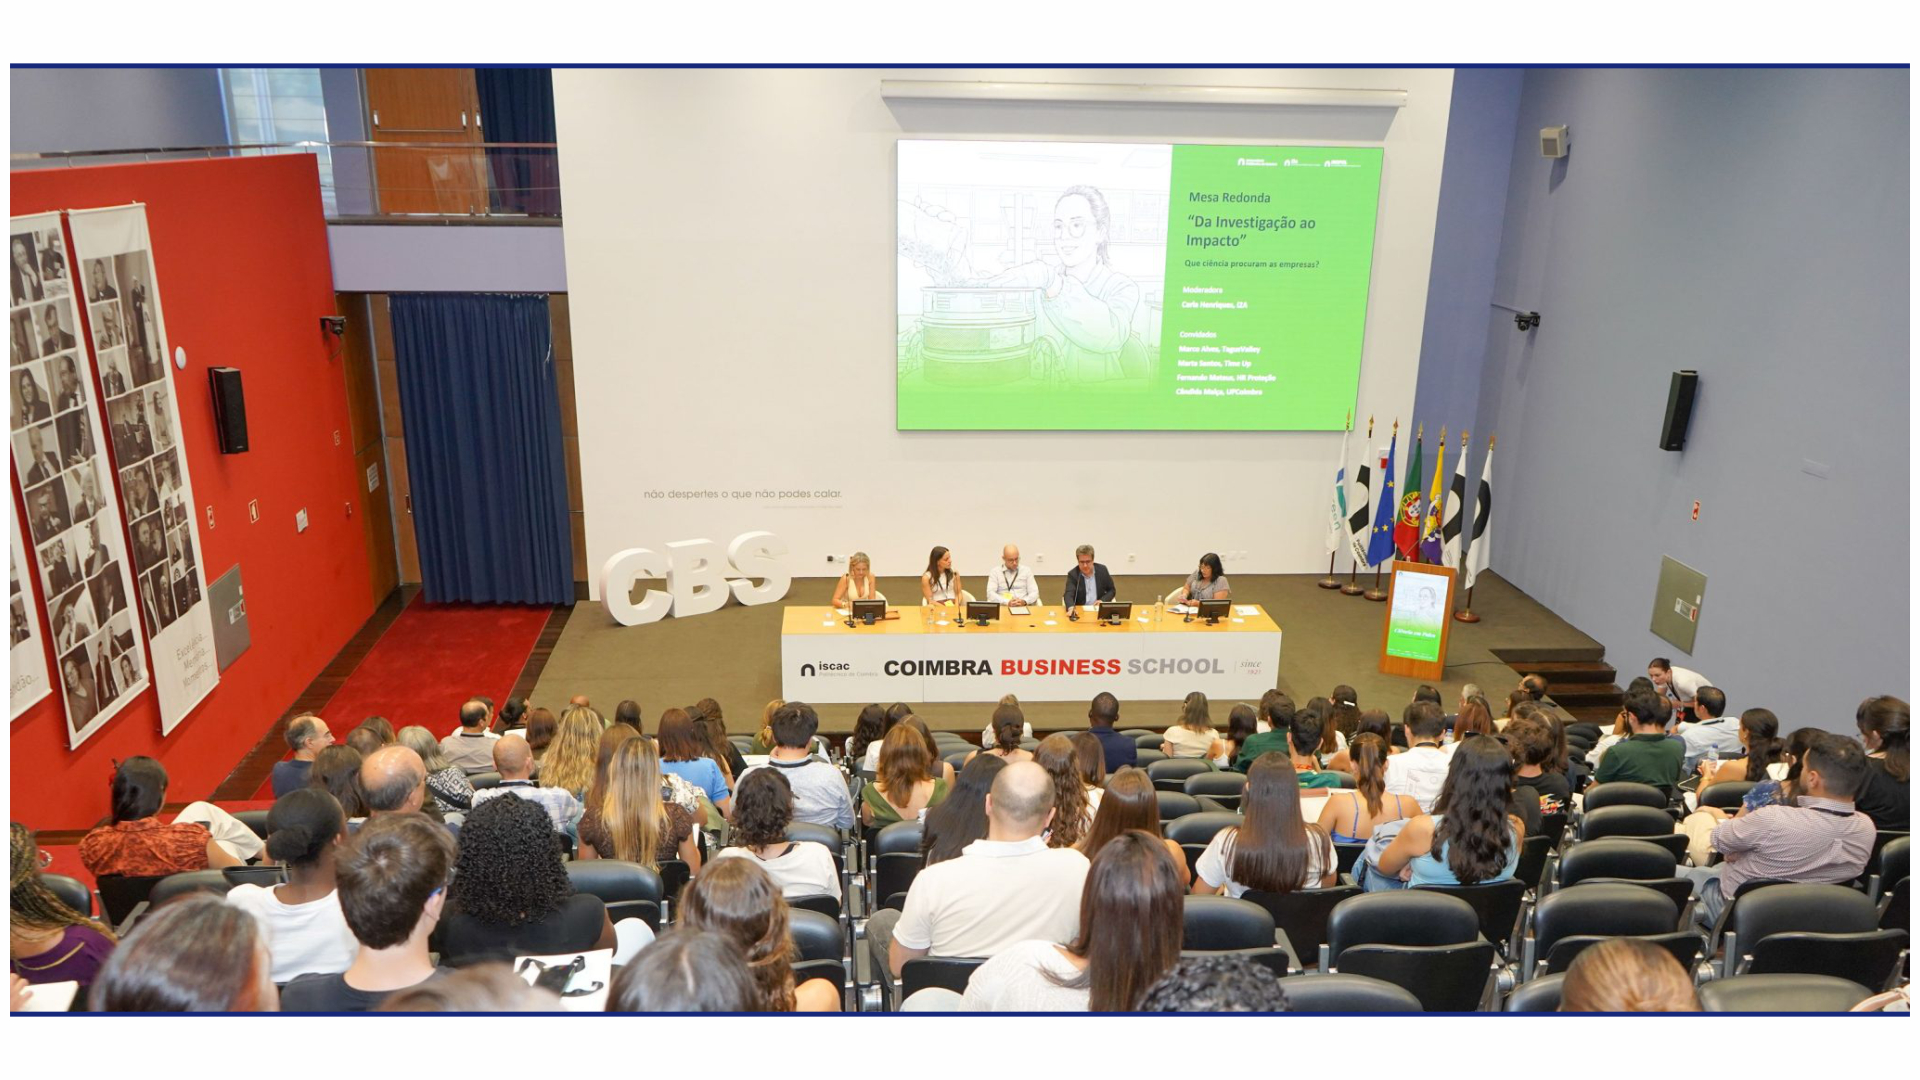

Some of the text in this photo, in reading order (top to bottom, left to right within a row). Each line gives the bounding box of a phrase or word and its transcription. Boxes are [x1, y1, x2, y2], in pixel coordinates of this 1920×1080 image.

[1189, 192, 1271, 203] Mesa Redonda
[1216, 215, 1296, 232] Investigação
[1299, 219, 1316, 229] ao
[1184, 259, 1200, 268] Que
[1202, 259, 1229, 267] ciência
[1230, 261, 1267, 269] procuram
[1279, 260, 1320, 269] empresas?
[1179, 345, 1200, 353] Marco
[1241, 360, 1252, 368] Up
[643, 489, 842, 500] não despertes o que não podes calar.
[599, 530, 792, 627] CBS
[818, 660, 850, 671] iscac
[884, 658, 1225, 676] COIMBRA BUSINESS SCHOOL
[1239, 658, 1262, 668] since
